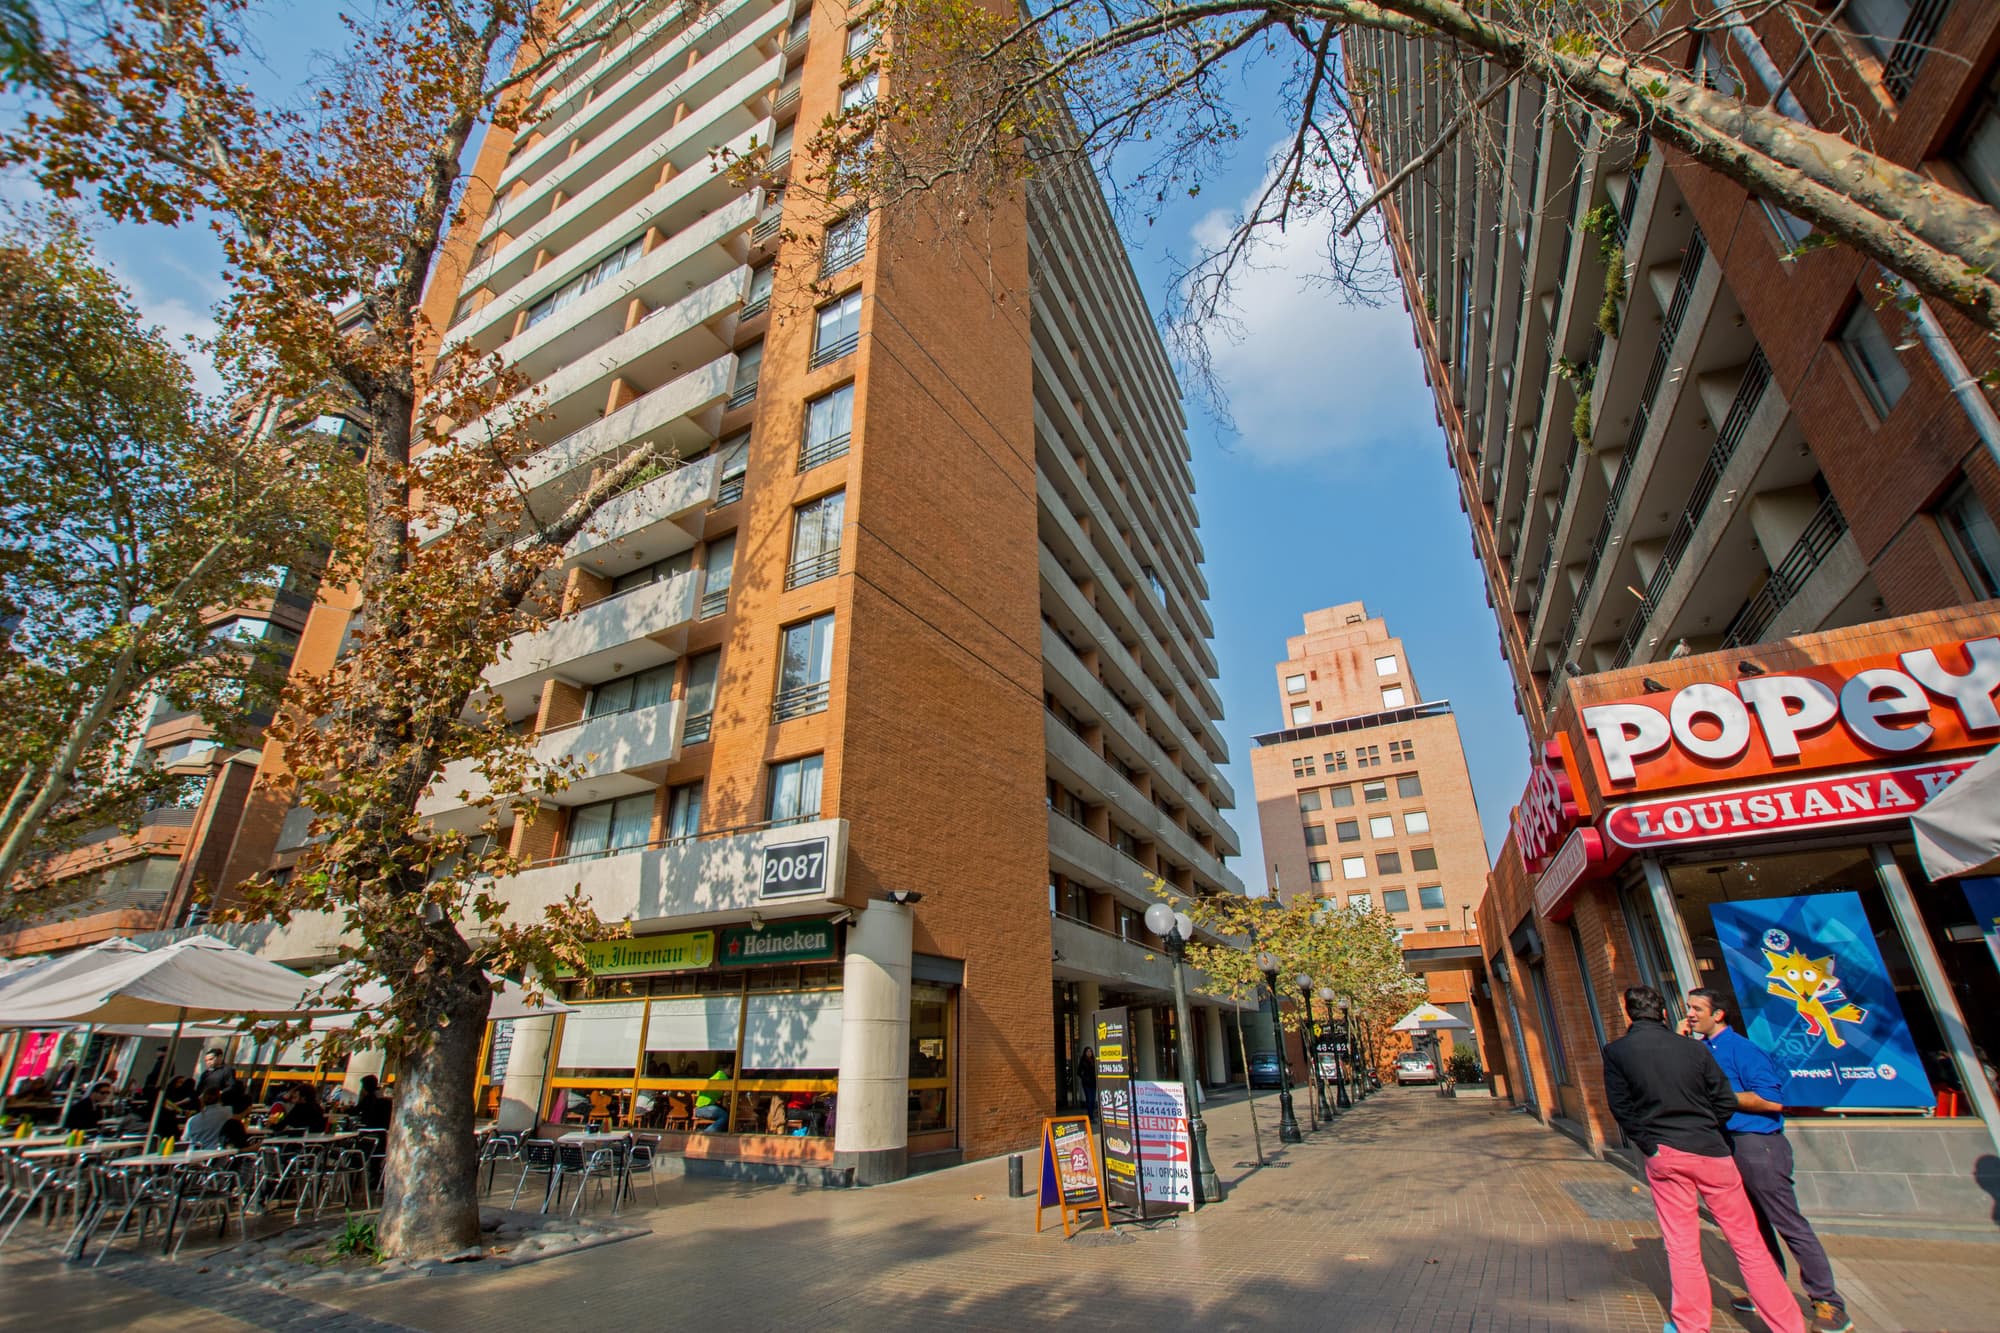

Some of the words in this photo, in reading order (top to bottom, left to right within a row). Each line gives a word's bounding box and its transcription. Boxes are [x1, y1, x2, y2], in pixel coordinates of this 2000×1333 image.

[1632, 778, 1915, 839] LOUISIANA
[765, 852, 822, 884] 2087
[743, 930, 827, 956] Heineken
